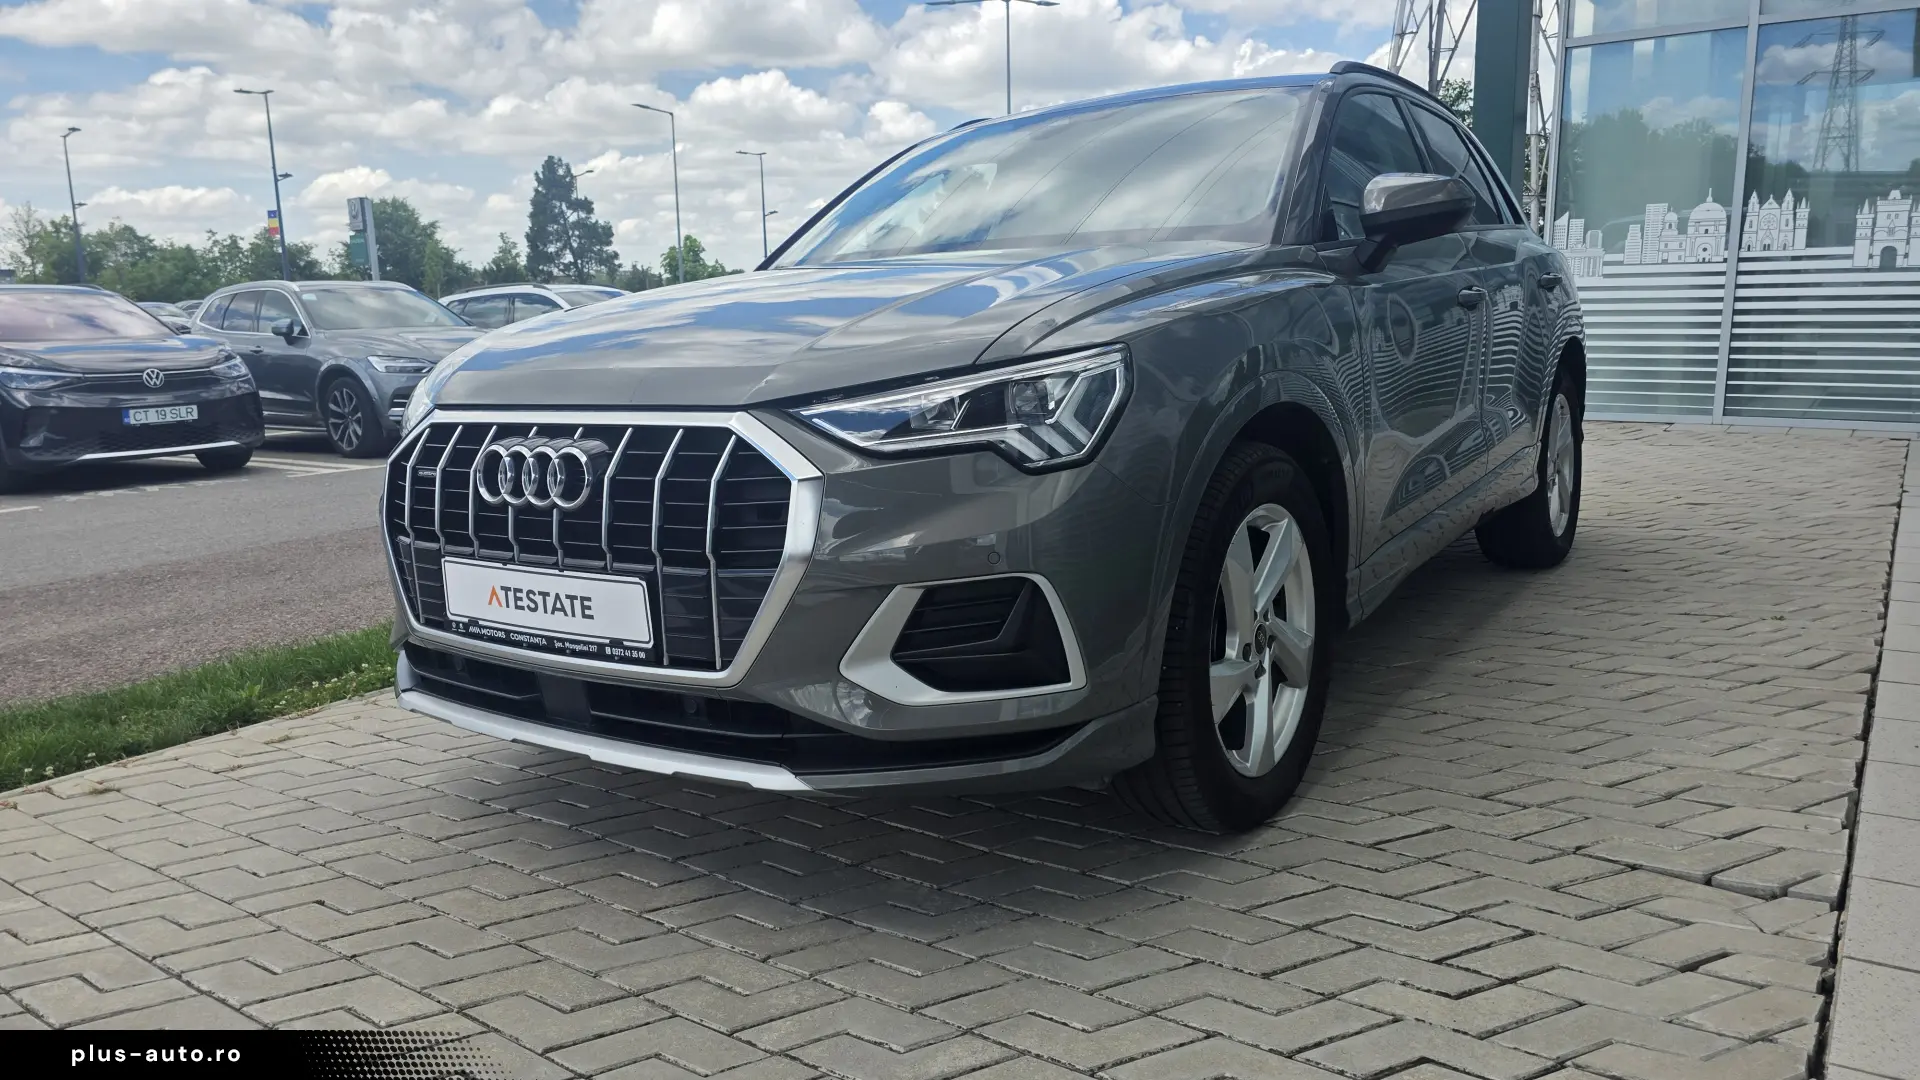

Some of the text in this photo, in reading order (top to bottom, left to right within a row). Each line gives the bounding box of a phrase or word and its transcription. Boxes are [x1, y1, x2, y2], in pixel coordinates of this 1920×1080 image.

[133, 410, 150, 422] CT
[155, 409, 167, 420] 19
[169, 407, 194, 419] SLR
[487, 584, 595, 620] ATESTATE
[481, 628, 506, 639] MOTORS
[588, 644, 598, 653] 217
[612, 647, 624, 656] 0372
[632, 650, 638, 658] 35
[638, 651, 646, 659] 00
